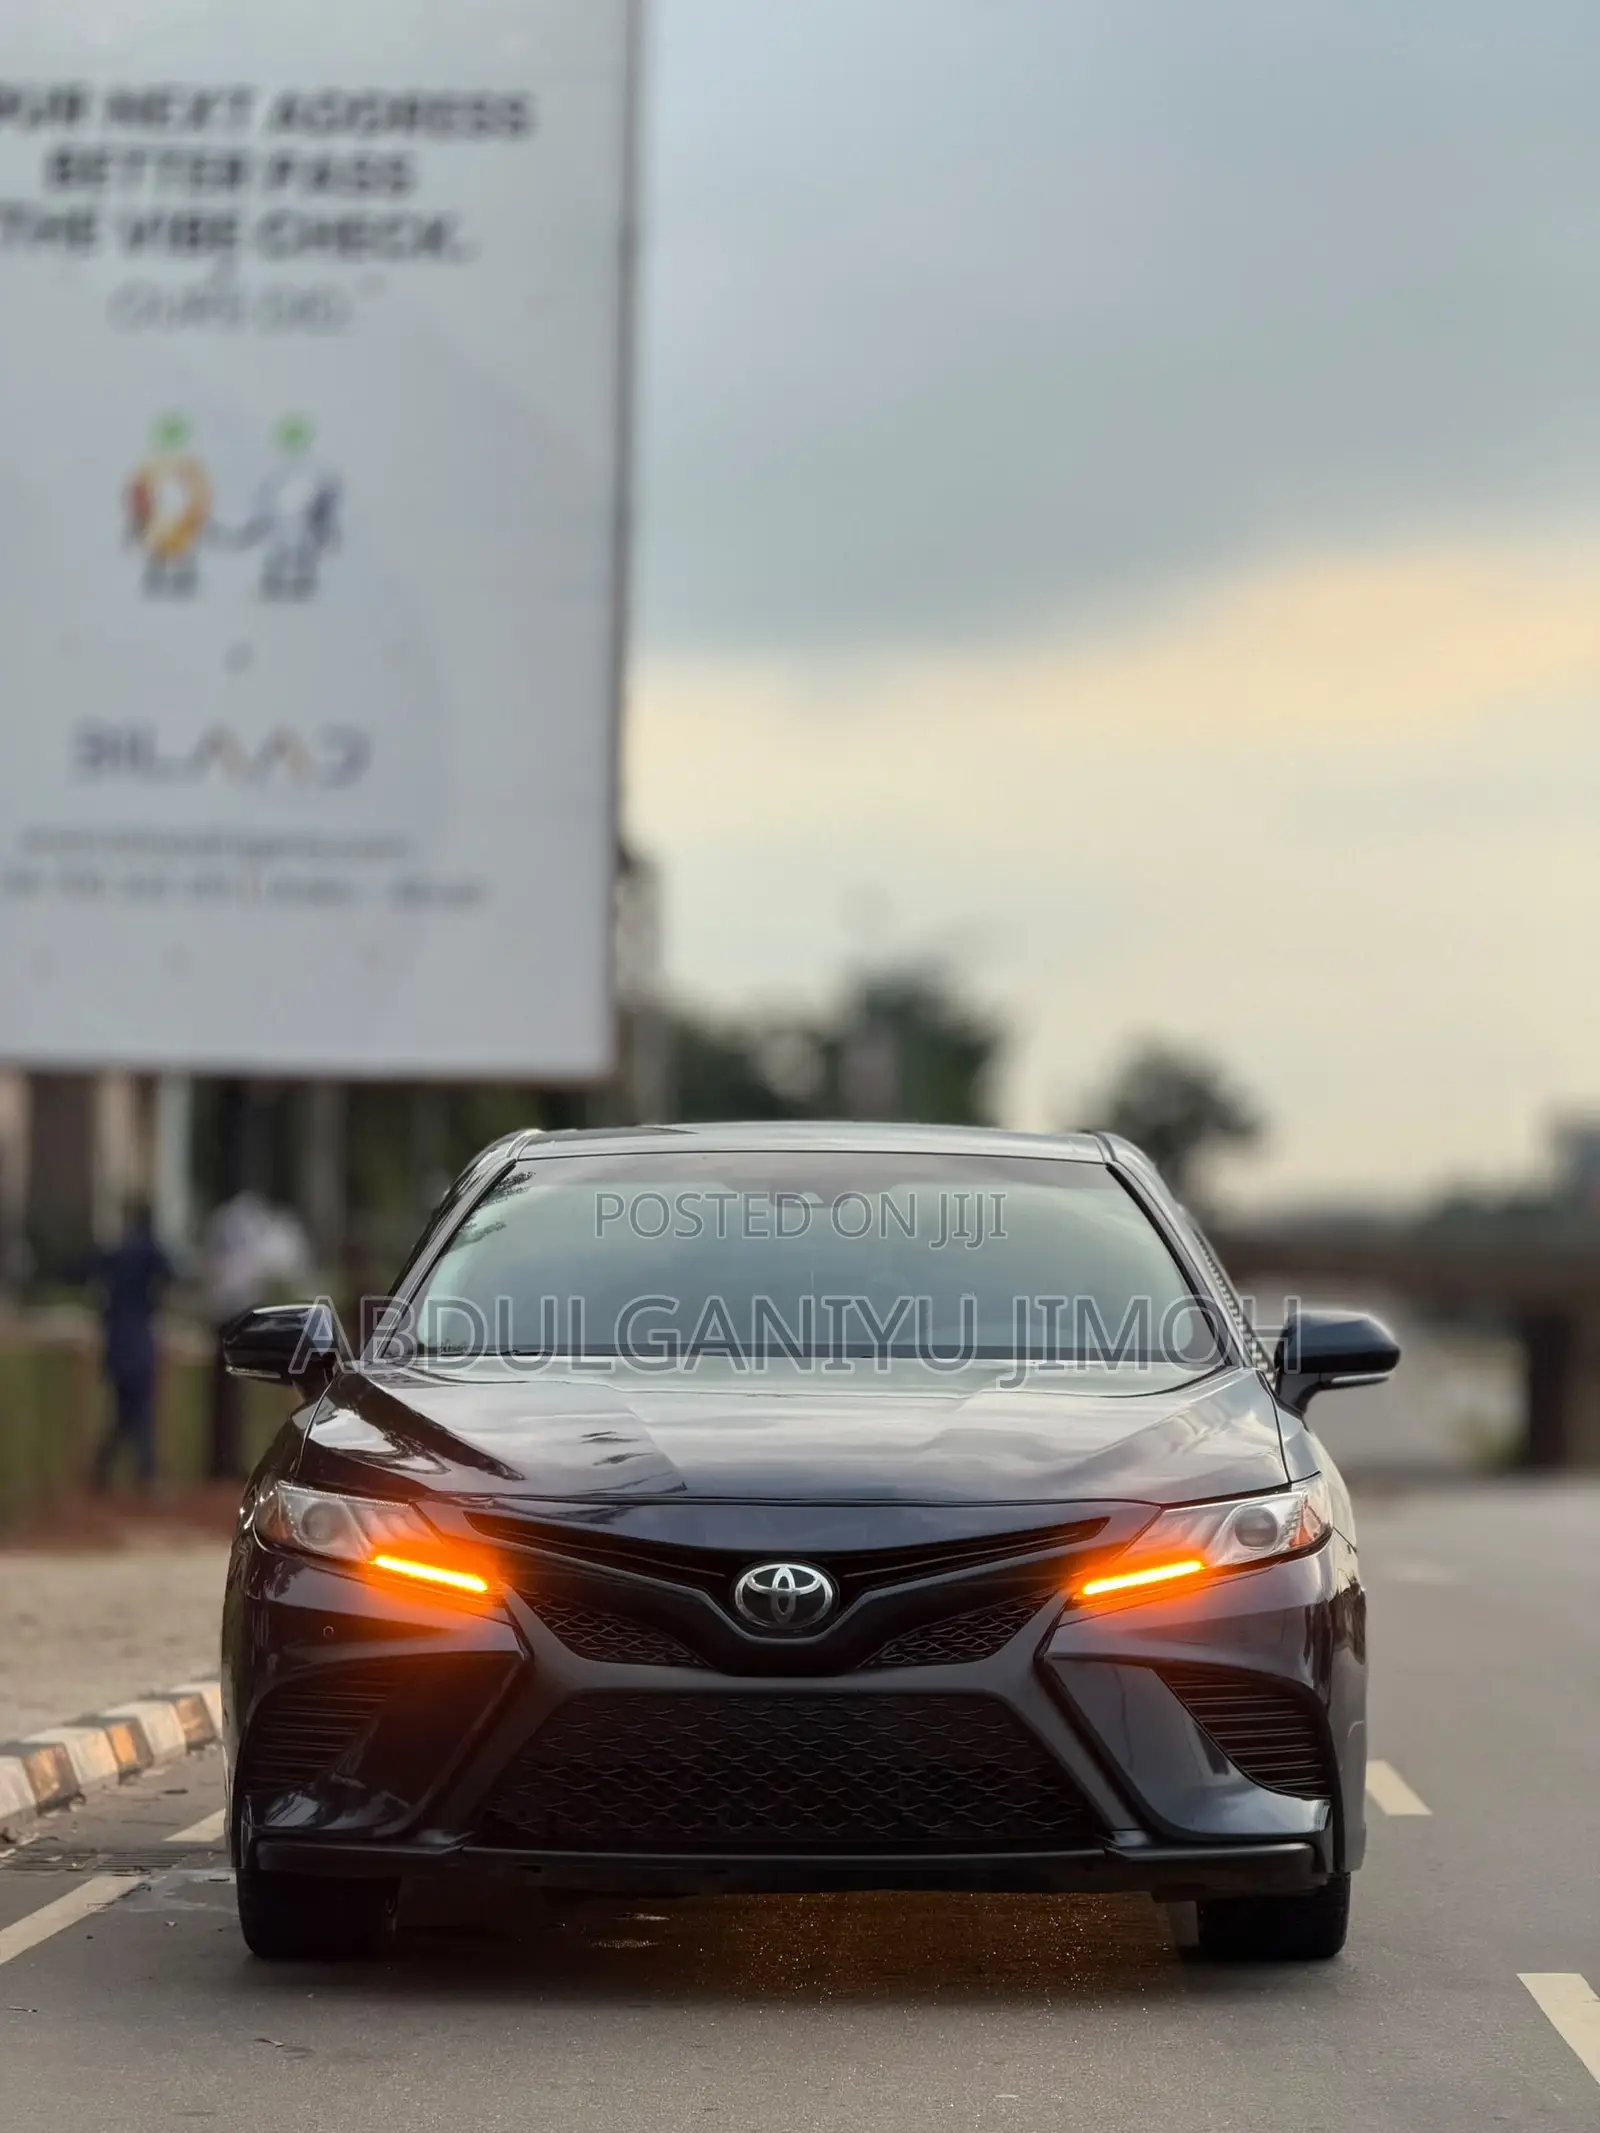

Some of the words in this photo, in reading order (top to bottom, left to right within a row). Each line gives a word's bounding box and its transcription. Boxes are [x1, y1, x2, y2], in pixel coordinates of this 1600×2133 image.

[105, 86, 255, 133] NEXT
[267, 90, 535, 139] ADDRESS
[45, 147, 247, 191] BETTER
[265, 149, 415, 196] PASS
[0, 204, 97, 253] THE
[117, 208, 241, 256] VIBE
